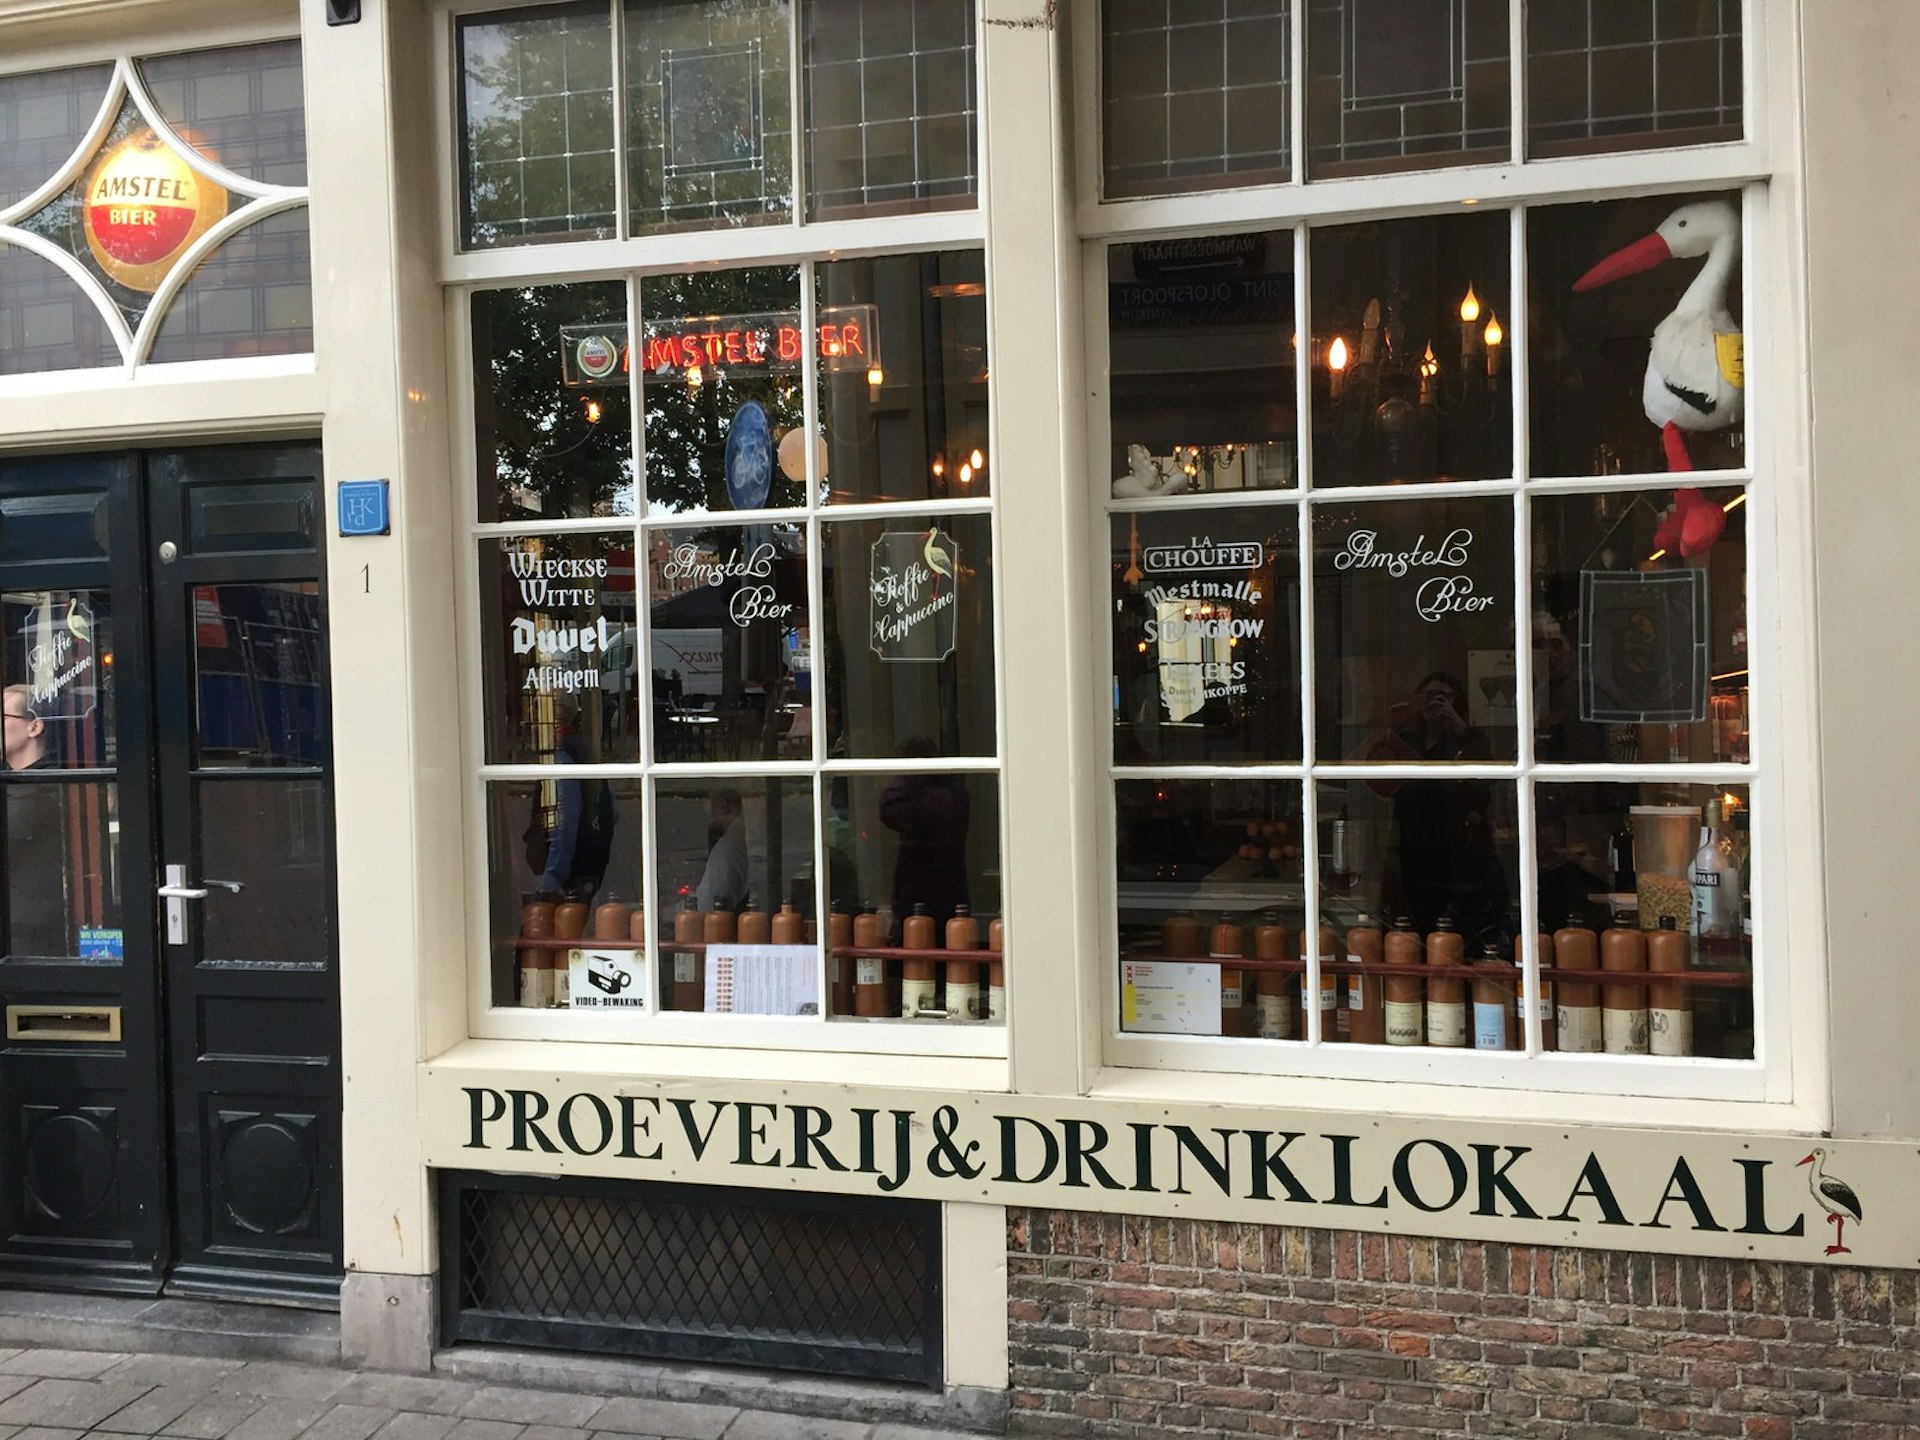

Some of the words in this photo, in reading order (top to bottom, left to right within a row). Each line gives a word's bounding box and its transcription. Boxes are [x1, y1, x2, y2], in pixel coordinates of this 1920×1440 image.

[97, 177, 186, 200] AMSTEL
[110, 208, 156, 225] BIER
[623, 334, 765, 372] MSTEL
[779, 325, 863, 359] BER
[1190, 535, 1213, 548] LA
[508, 552, 608, 579] WIECKSE
[1149, 547, 1256, 568] CHOUFFE
[360, 562, 370, 594] 1
[518, 579, 596, 607] WITTE
[729, 585, 793, 627] Bier
[1144, 579, 1262, 607] Westmalle
[1415, 575, 1494, 622] Bier
[873, 592, 953, 643] Cappuccino
[509, 615, 609, 654] Duvel
[522, 666, 600, 693] Affligem
